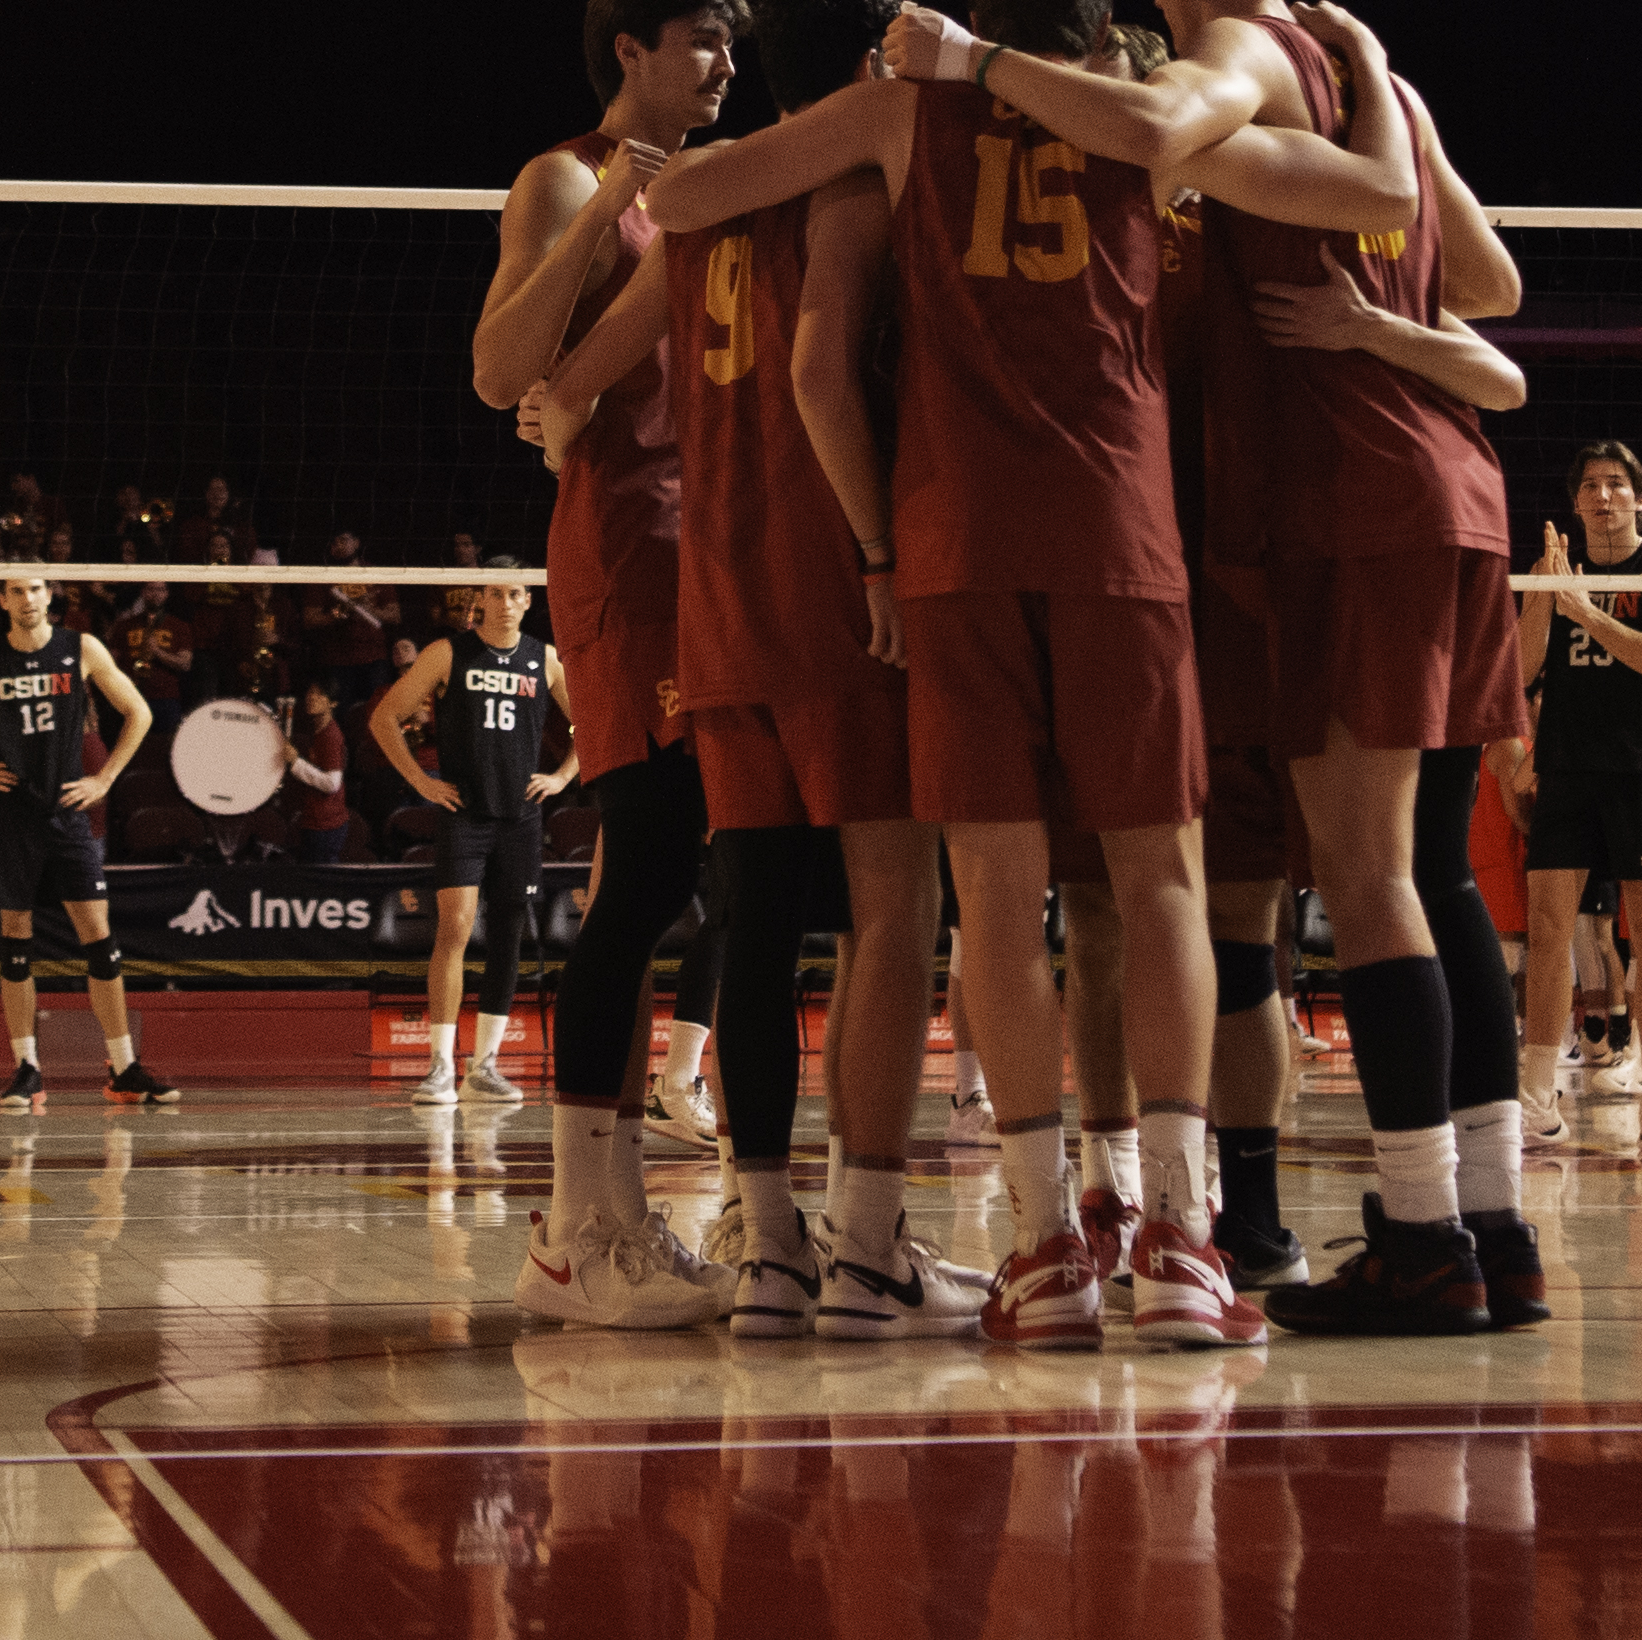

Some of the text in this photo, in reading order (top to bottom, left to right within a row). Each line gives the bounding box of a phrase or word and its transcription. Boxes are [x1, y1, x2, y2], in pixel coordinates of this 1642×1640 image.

[962, 134, 1091, 283] 15
[703, 235, 756, 386] 9
[465, 669, 538, 699] CSUN
[19, 701, 56, 736] 12
[483, 697, 516, 731] 16
[389, 1021, 431, 1032] WELL
[390, 1033, 431, 1045] FARG
